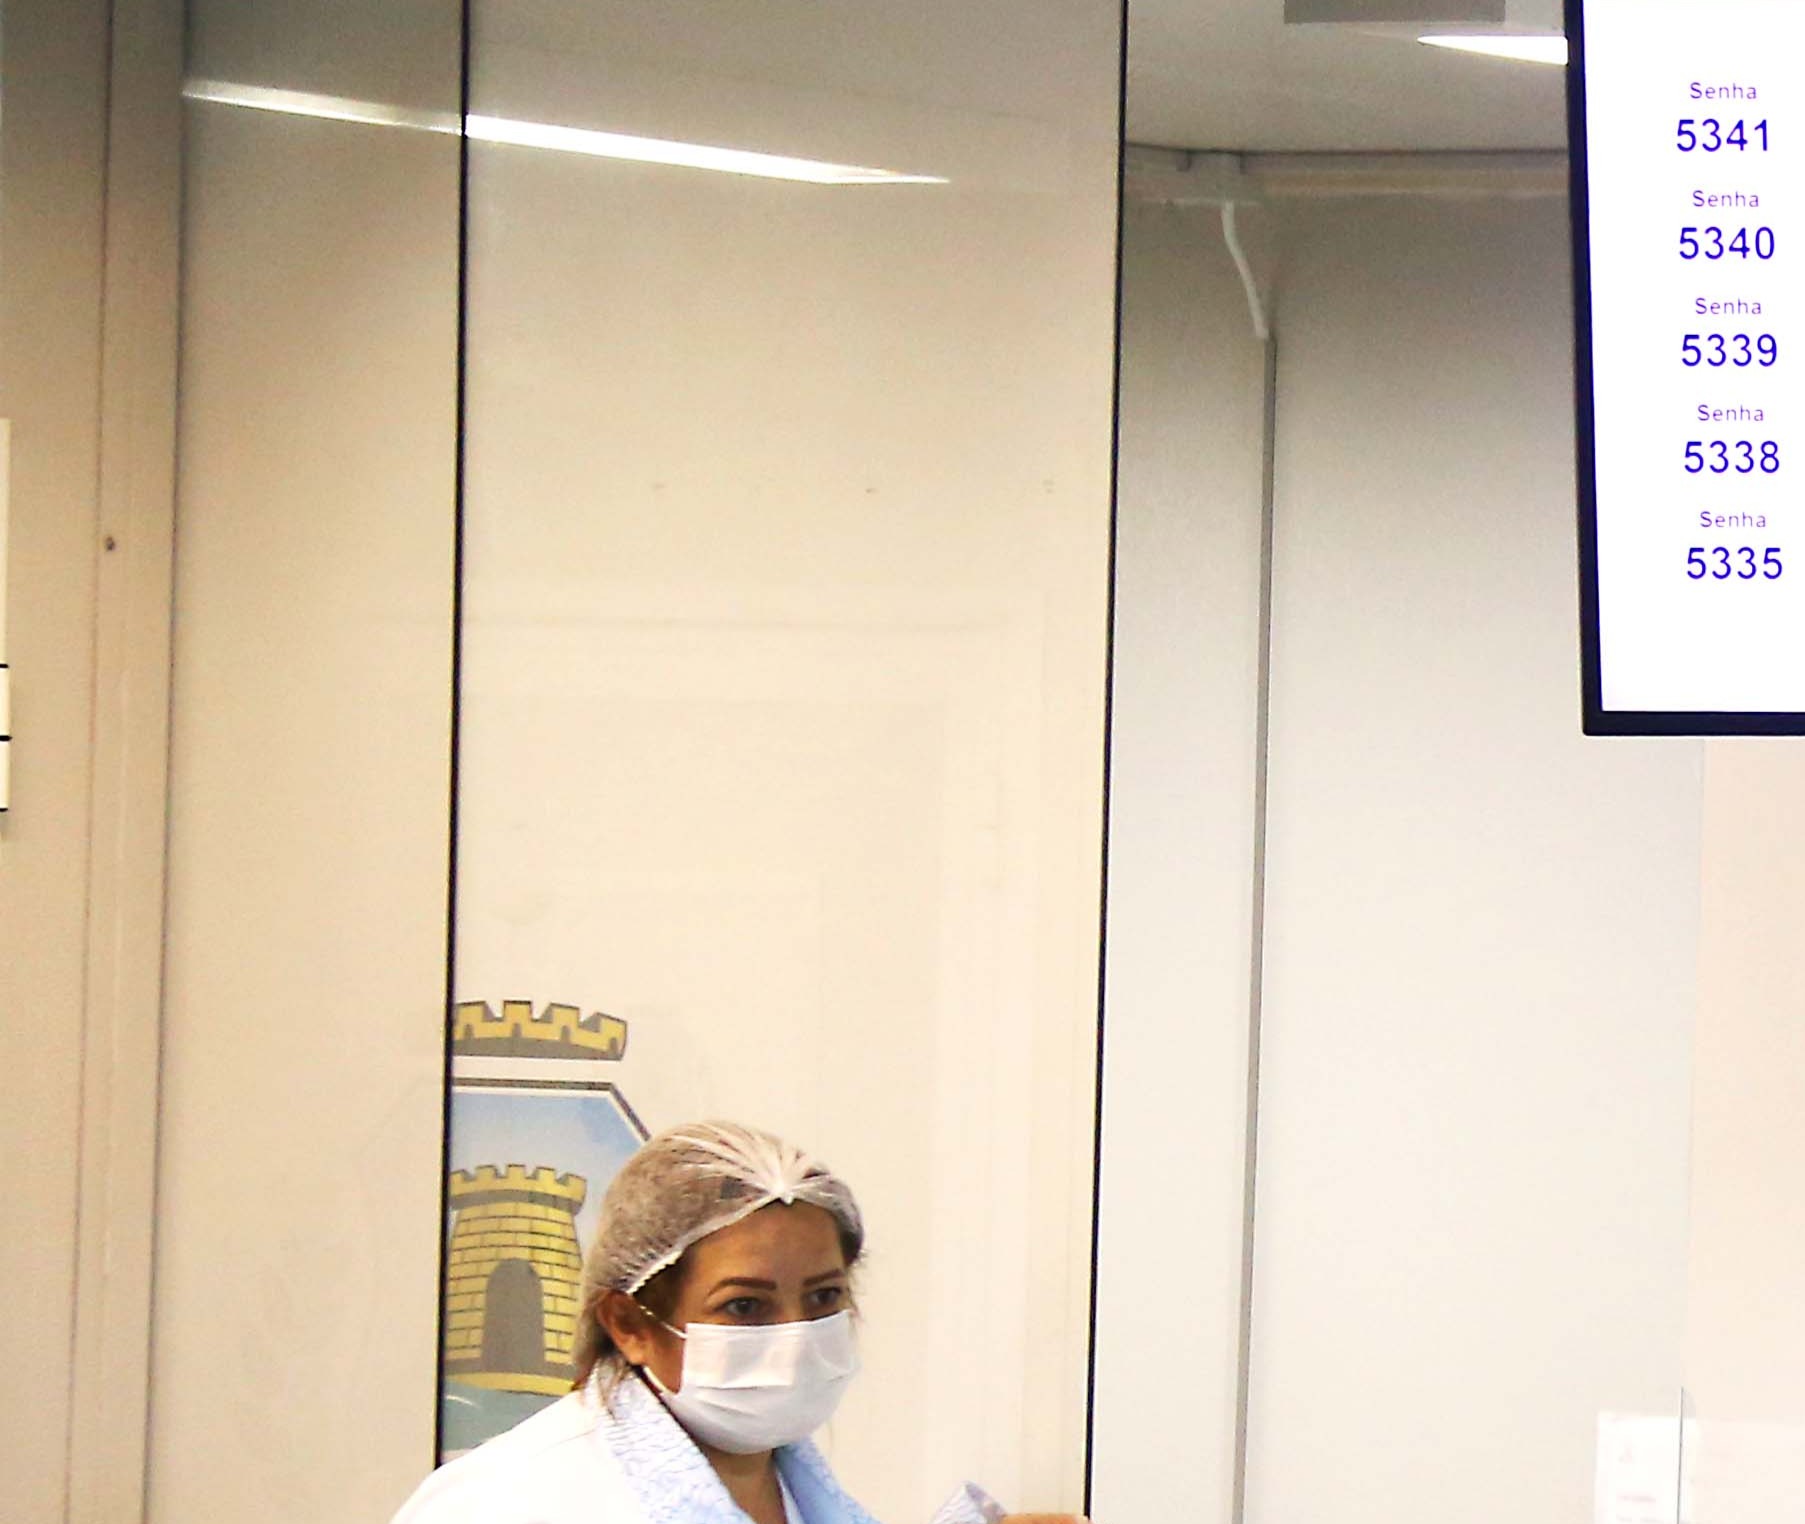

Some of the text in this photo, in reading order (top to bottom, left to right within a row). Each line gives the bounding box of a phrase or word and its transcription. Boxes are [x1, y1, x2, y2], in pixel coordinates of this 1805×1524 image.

[1690, 82, 1757, 100] Senha
[1677, 119, 1770, 152] 5341
[1692, 190, 1759, 208] Senha
[1680, 227, 1775, 260] 5340
[1695, 297, 1762, 315] Senha
[1682, 334, 1778, 367] 5339
[1697, 404, 1764, 422] Senha
[1685, 441, 1780, 474] 5338
[1700, 511, 1767, 529] Senha
[1687, 547, 1783, 580] 5335
